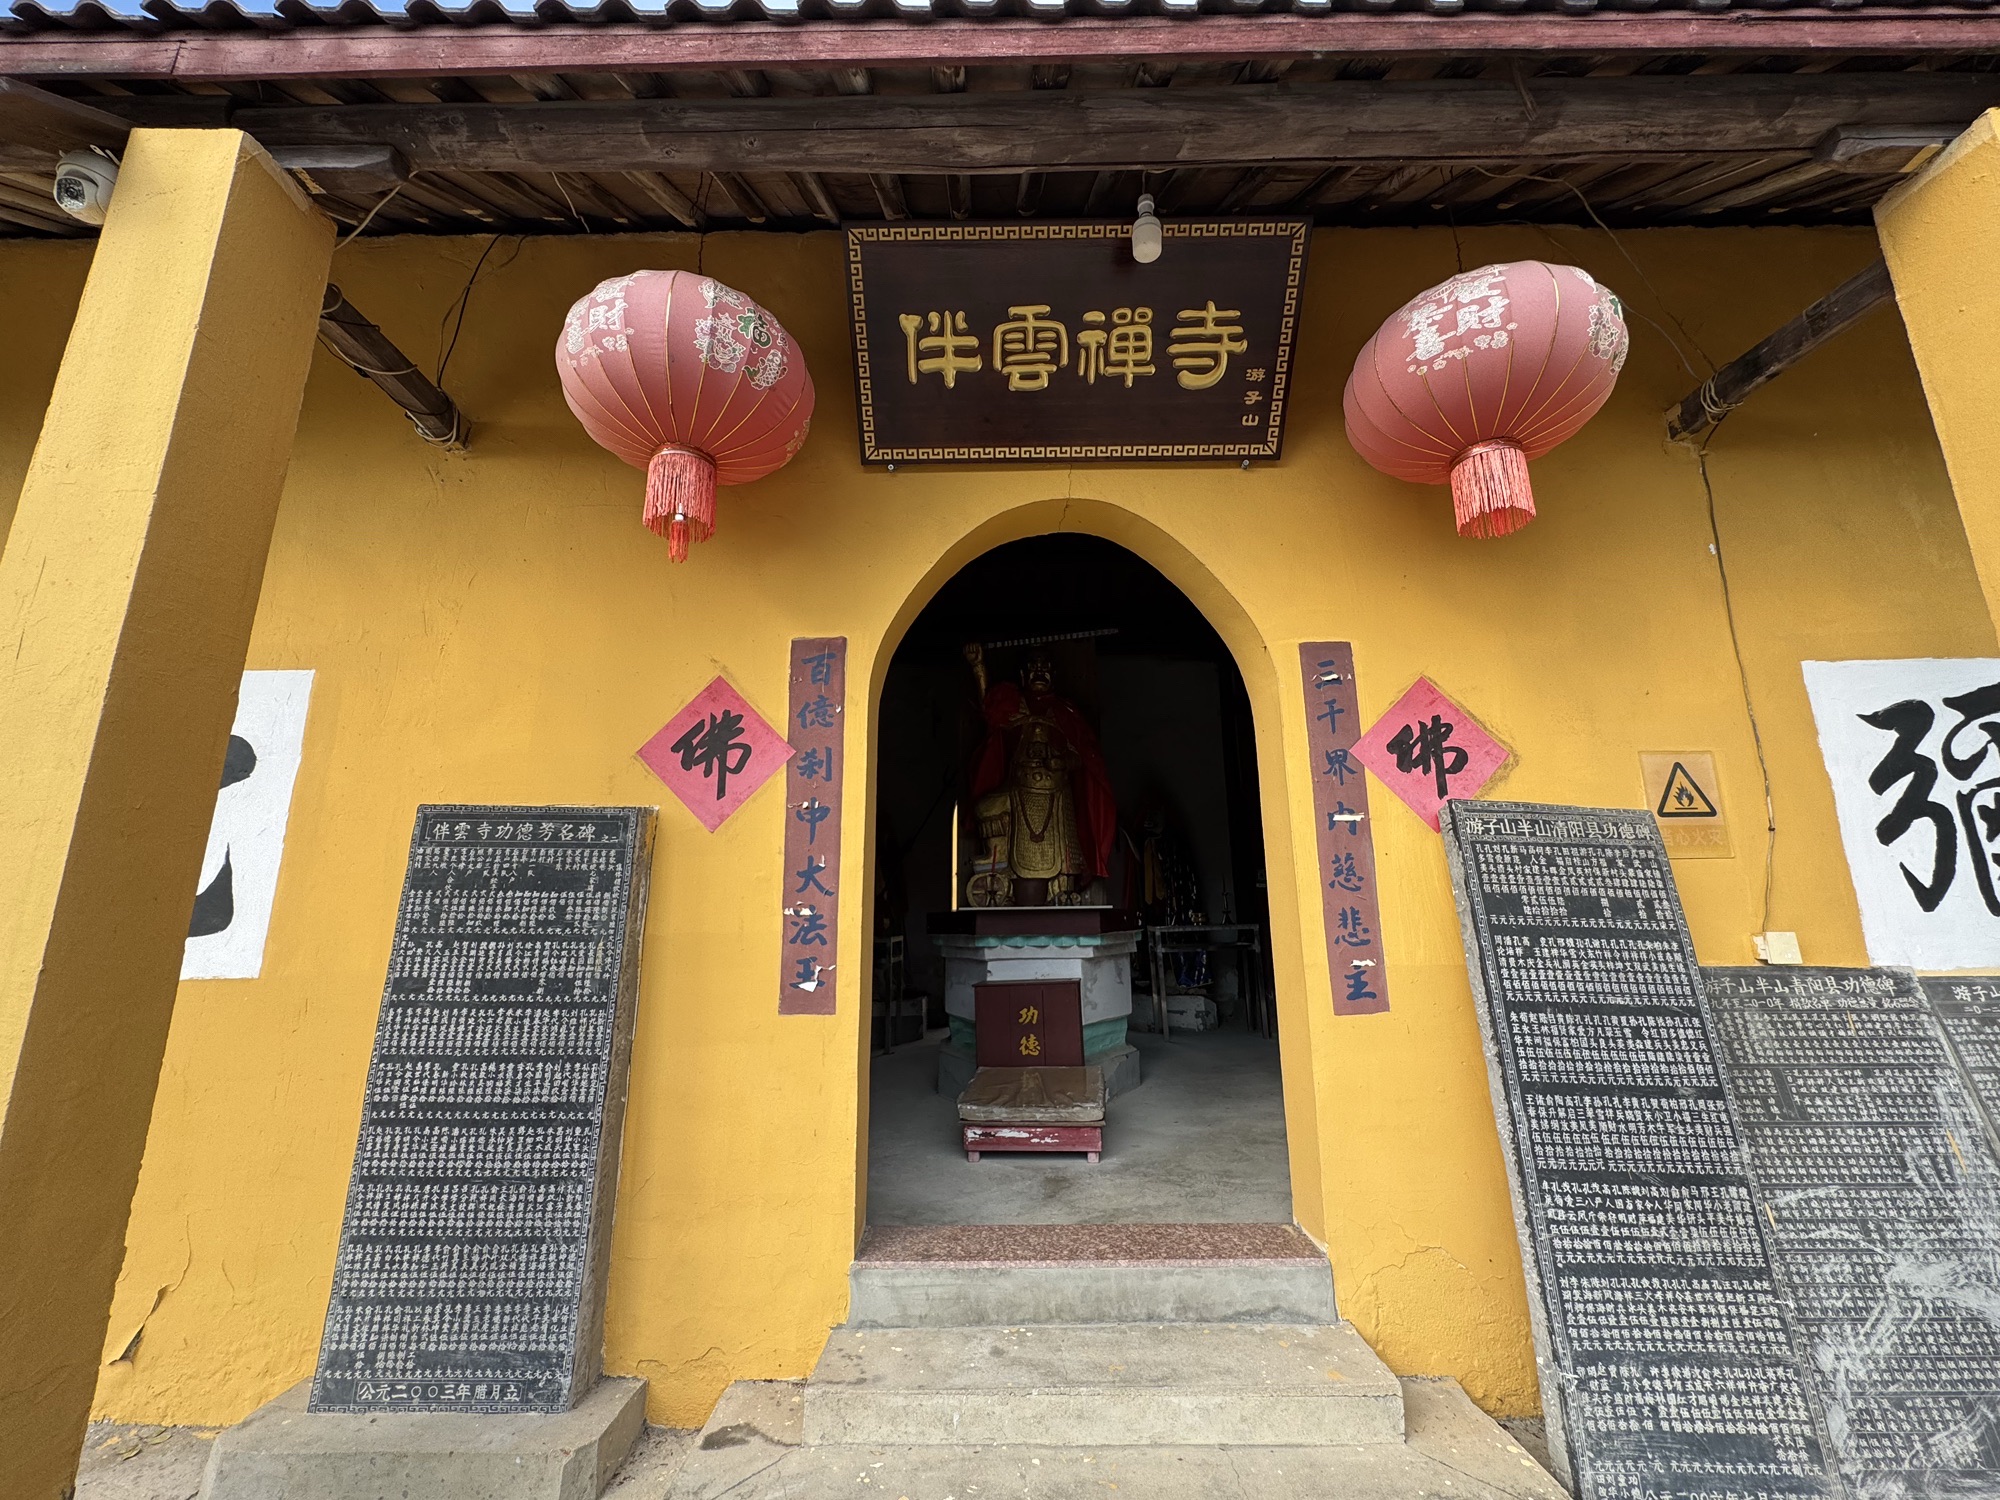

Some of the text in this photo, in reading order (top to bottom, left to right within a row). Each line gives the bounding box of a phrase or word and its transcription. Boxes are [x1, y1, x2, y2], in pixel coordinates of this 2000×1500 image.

[670, 709, 753, 801] 佛
[1386, 714, 1469, 801] 佛
[1018, 1005, 1041, 1056] 功德
